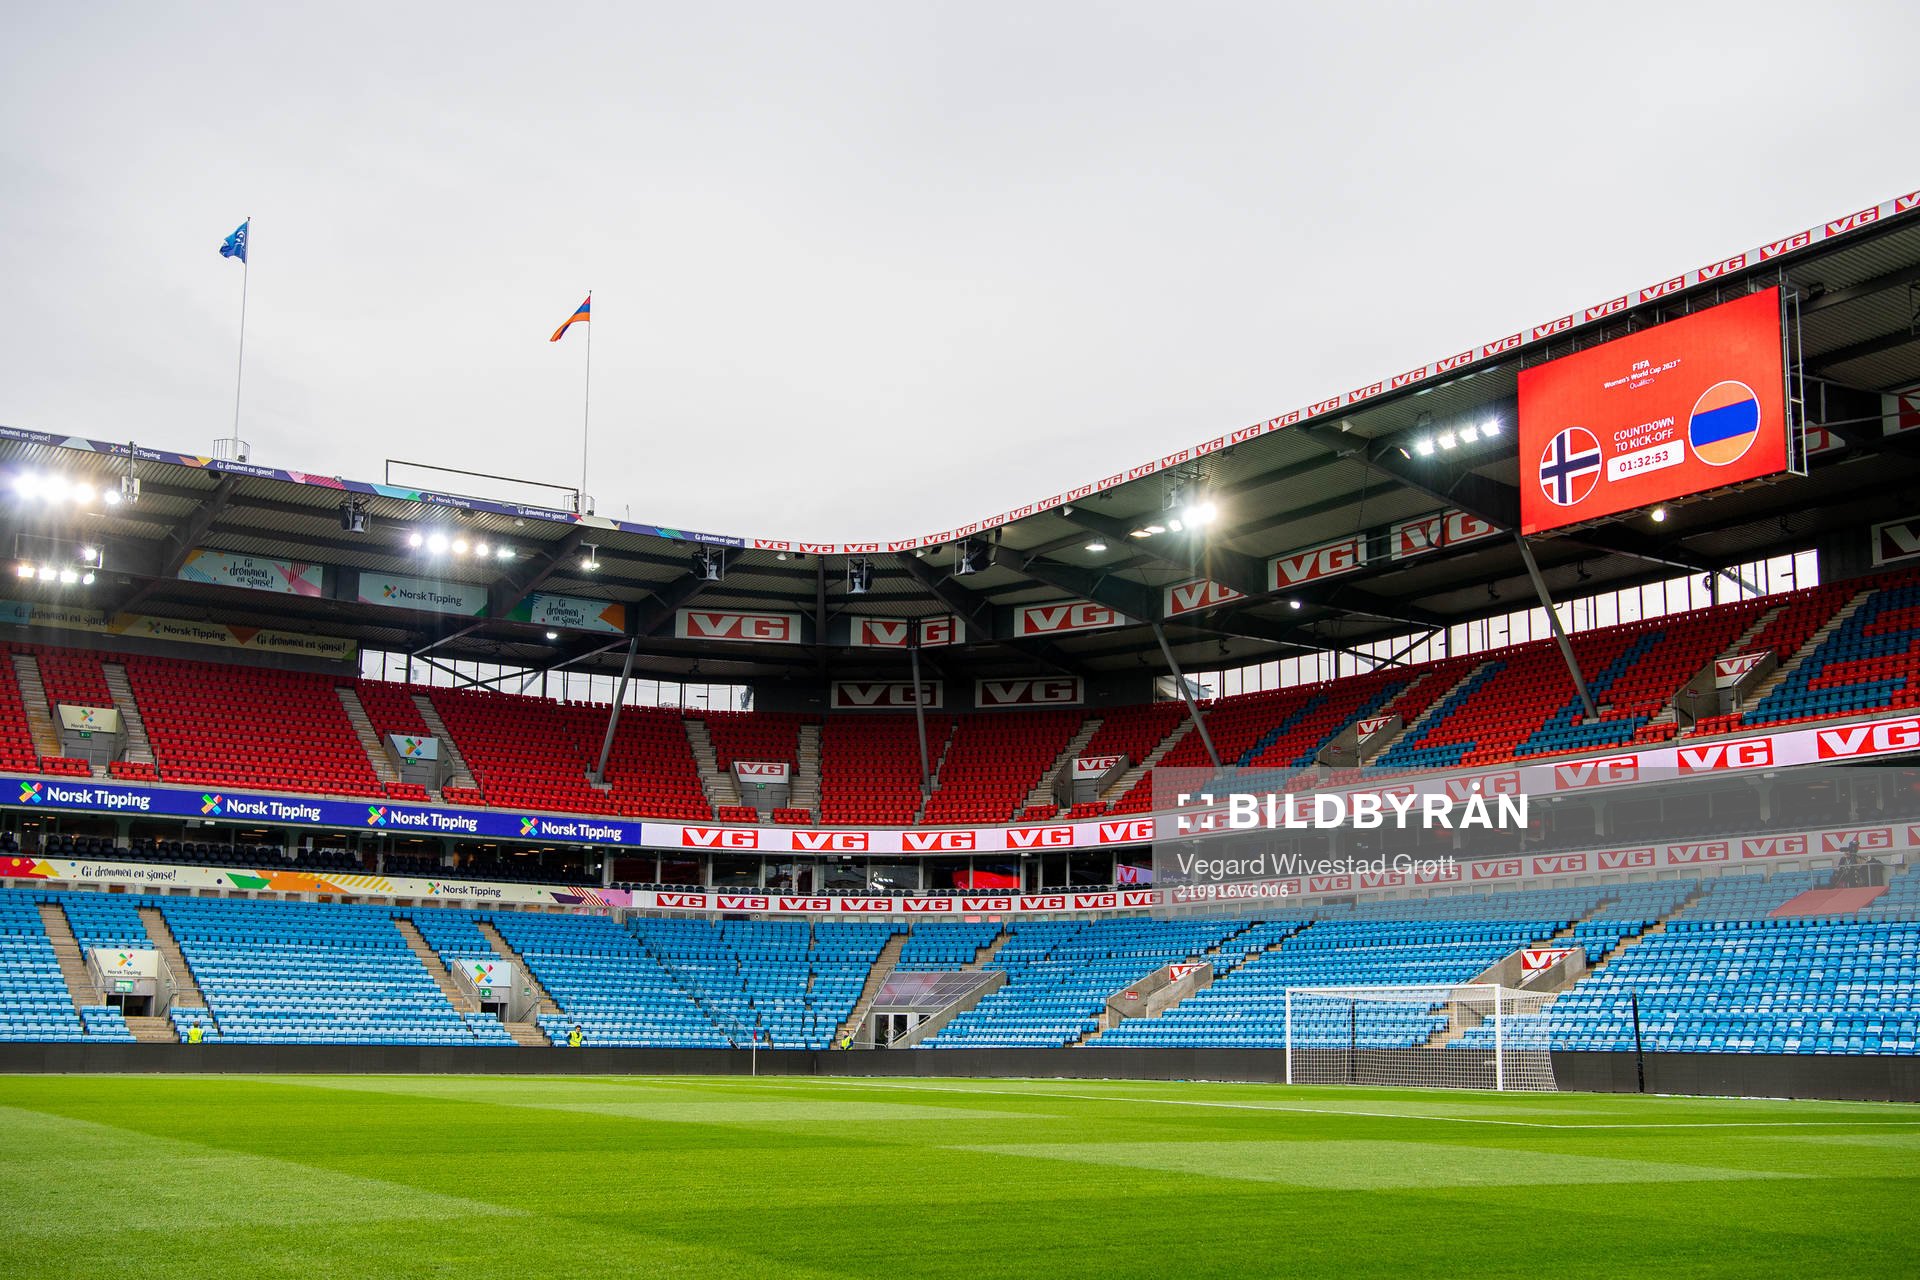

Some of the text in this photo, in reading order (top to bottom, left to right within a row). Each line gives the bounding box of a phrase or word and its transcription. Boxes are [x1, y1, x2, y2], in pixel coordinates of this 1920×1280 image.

[1898, 193, 1920, 208] V
[1827, 209, 1877, 233] VG
[1762, 233, 1808, 257] VG
[1700, 256, 1744, 279] VG
[1642, 278, 1684, 300] VG
[1587, 299, 1626, 319] VG
[1535, 317, 1572, 337] VG
[1485, 336, 1520, 355] VG
[1438, 353, 1472, 371] VG
[1632, 359, 1650, 371] FIFA
[1393, 369, 1426, 387] VG
[1631, 370, 1649, 381] World
[1351, 384, 1382, 401] VG
[1309, 399, 1339, 416] VG
[1271, 413, 1299, 429] VG
[1613, 416, 1675, 441] COUNTDOWN
[1233, 427, 1260, 442] VG
[1616, 428, 1674, 453] TO KICK-OFF
[1197, 440, 1223, 455] VG
[1163, 452, 1188, 467] VG
[1619, 451, 1669, 472] 01:32:53
[1131, 464, 1154, 479] VG
[1099, 476, 1122, 489] VG
[1069, 486, 1091, 500] VG
[436, 496, 470, 508] Norsk Tipping
[1039, 497, 1060, 510] VG
[983, 515, 1004, 529] VG
[1011, 507, 1031, 520] VG
[925, 533, 950, 545] VG
[957, 525, 976, 538] VG
[757, 540, 789, 550] VG
[802, 544, 833, 553] VG
[846, 544, 876, 552] VG
[890, 540, 915, 551] VG
[229, 562, 268, 579] drømmen
[245, 559, 253, 568] Gi
[1281, 545, 1352, 584] VG
[246, 576, 274, 588] sjanse!
[400, 589, 463, 607] Norsk Tipping
[559, 599, 566, 607] Gi
[692, 614, 784, 639] VG
[1027, 603, 1109, 633] VG
[163, 625, 226, 641] Norsk Tipping
[257, 634, 266, 645] Gi
[865, 620, 949, 645] VG
[843, 683, 931, 706] VG
[986, 680, 1073, 703] VG
[1820, 721, 1920, 755] VG
[1679, 740, 1771, 771] VG
[741, 764, 781, 774] VG
[1556, 758, 1636, 788] VG
[47, 786, 150, 811] Norsk Tipping
[227, 799, 321, 821] Norsk Tipping
[391, 811, 477, 832] Norsk Tipping
[542, 822, 622, 842] Norsk Tipping
[684, 828, 756, 848] VG
[1008, 827, 1071, 847] VG
[1101, 821, 1152, 841] VG
[794, 833, 866, 850] VG
[903, 833, 973, 850] VG
[1744, 837, 1805, 856] VG
[1825, 830, 1890, 850] VG
[1600, 849, 1653, 868] VG
[1671, 843, 1725, 862] VG
[81, 865, 92, 877] Gi
[134, 869, 144, 878] en
[146, 869, 177, 881] sjanse!
[1474, 861, 1520, 879] VG
[1535, 855, 1584, 874] VG
[1311, 876, 1349, 891] VG
[1362, 872, 1403, 888] VG
[443, 884, 501, 898] Norsk Tipping
[1125, 892, 1162, 905] VG
[658, 894, 704, 907] VG
[719, 897, 767, 910] VG
[781, 899, 829, 911] VG
[842, 899, 890, 911] VG
[903, 899, 950, 911] VG
[964, 898, 1009, 911] VG
[1022, 897, 1063, 909] VG
[1075, 895, 1114, 908] VG
